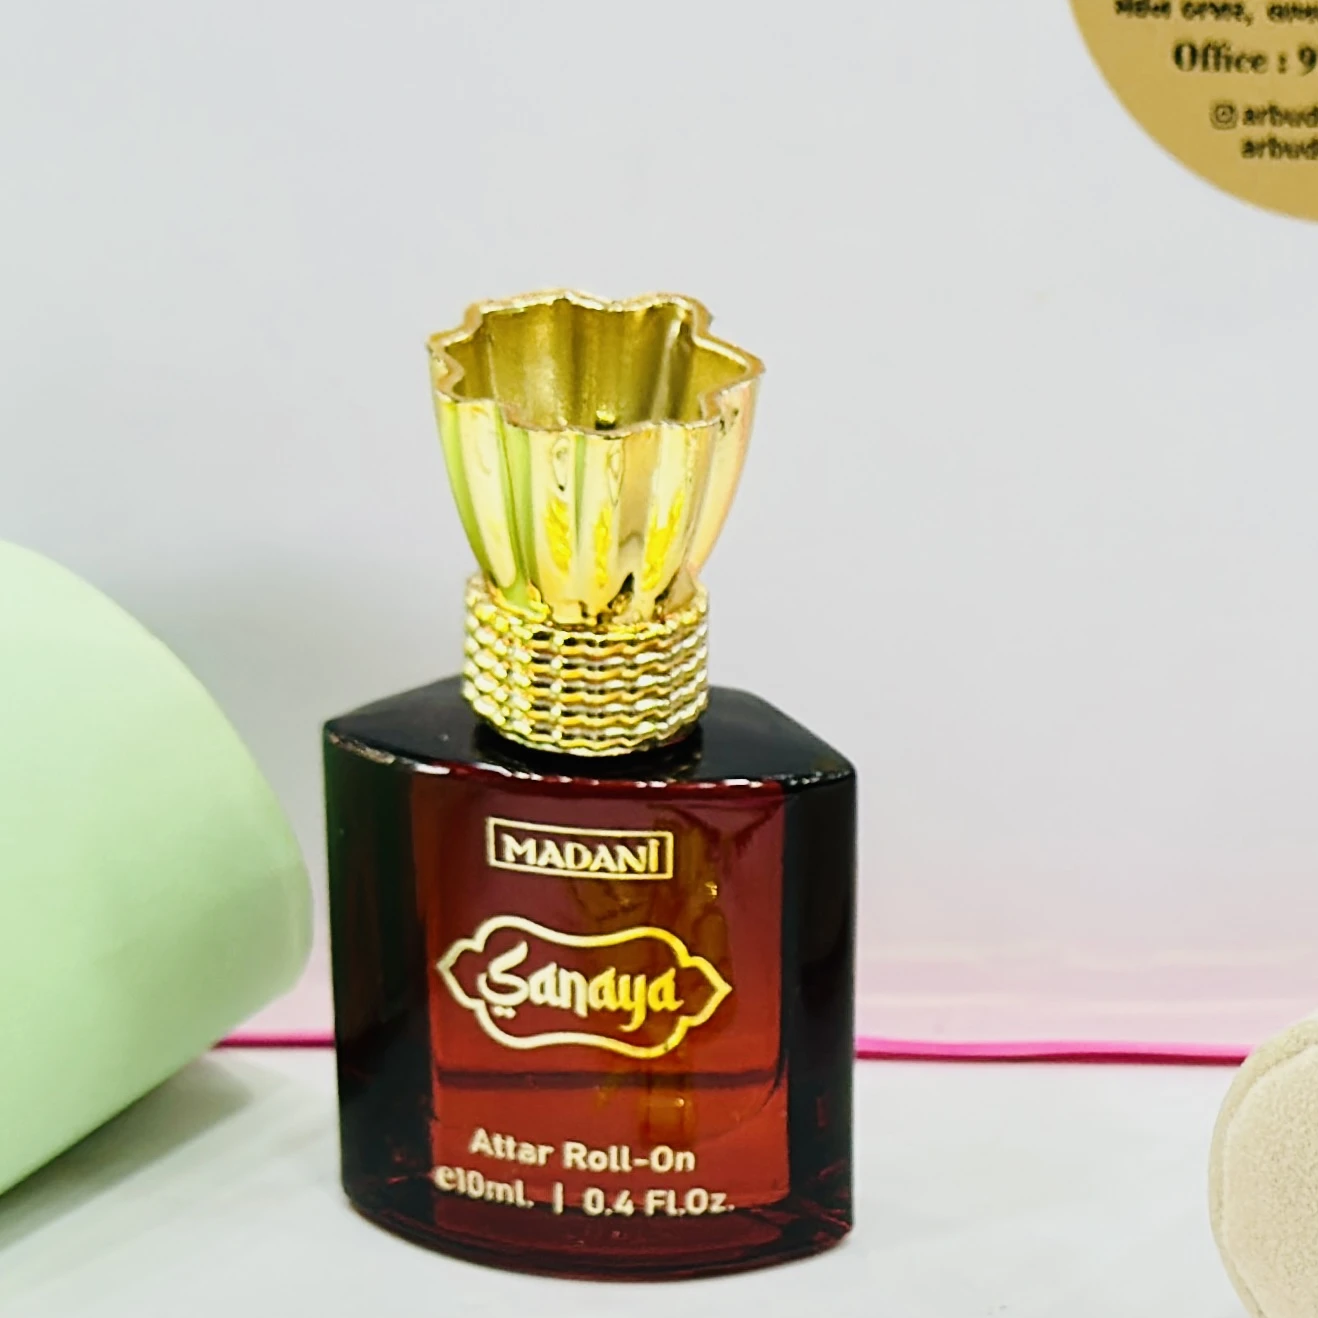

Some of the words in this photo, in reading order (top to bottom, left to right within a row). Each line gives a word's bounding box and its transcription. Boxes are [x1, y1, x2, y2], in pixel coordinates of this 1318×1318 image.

[1173, 41, 1268, 73] Office
[477, 940, 684, 1032] Sanaya
[467, 1127, 555, 1166] Attar
[561, 1140, 697, 1173] Roll-On
[583, 1186, 636, 1216] 0.4
